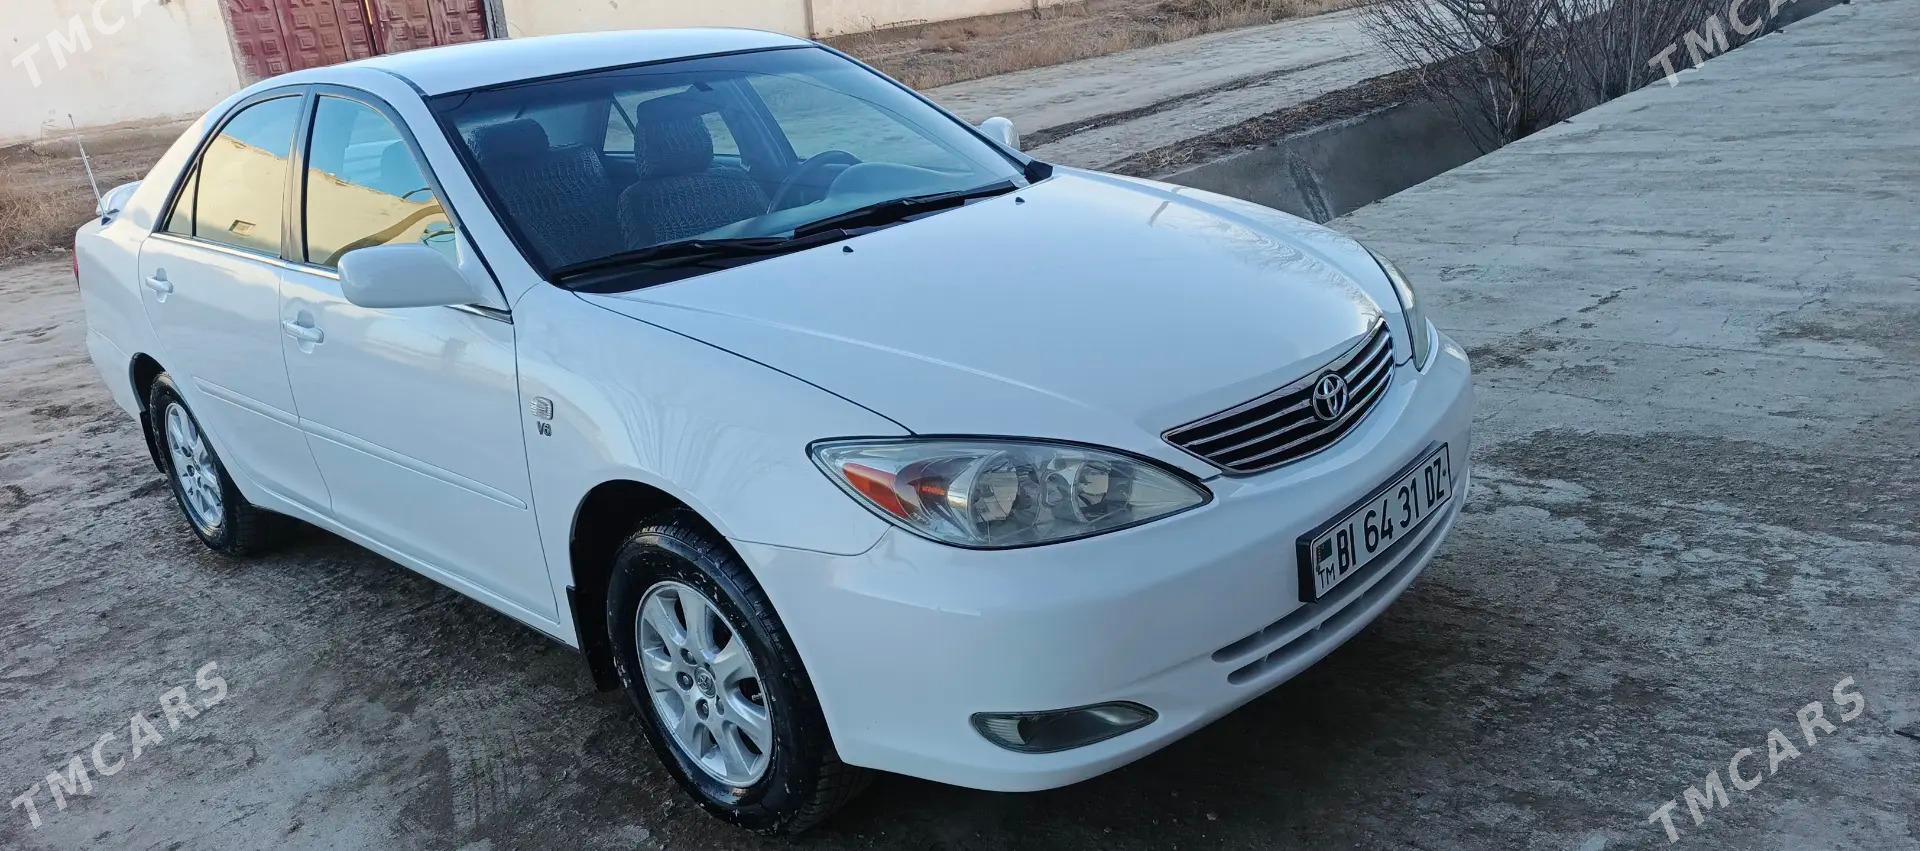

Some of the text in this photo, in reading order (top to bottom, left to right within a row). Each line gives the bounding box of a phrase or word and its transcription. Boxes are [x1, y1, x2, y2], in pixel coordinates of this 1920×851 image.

[537, 421, 552, 437] V6
[1336, 457, 1445, 576] BI 64 31 DZ
[1317, 563, 1336, 589] TM
